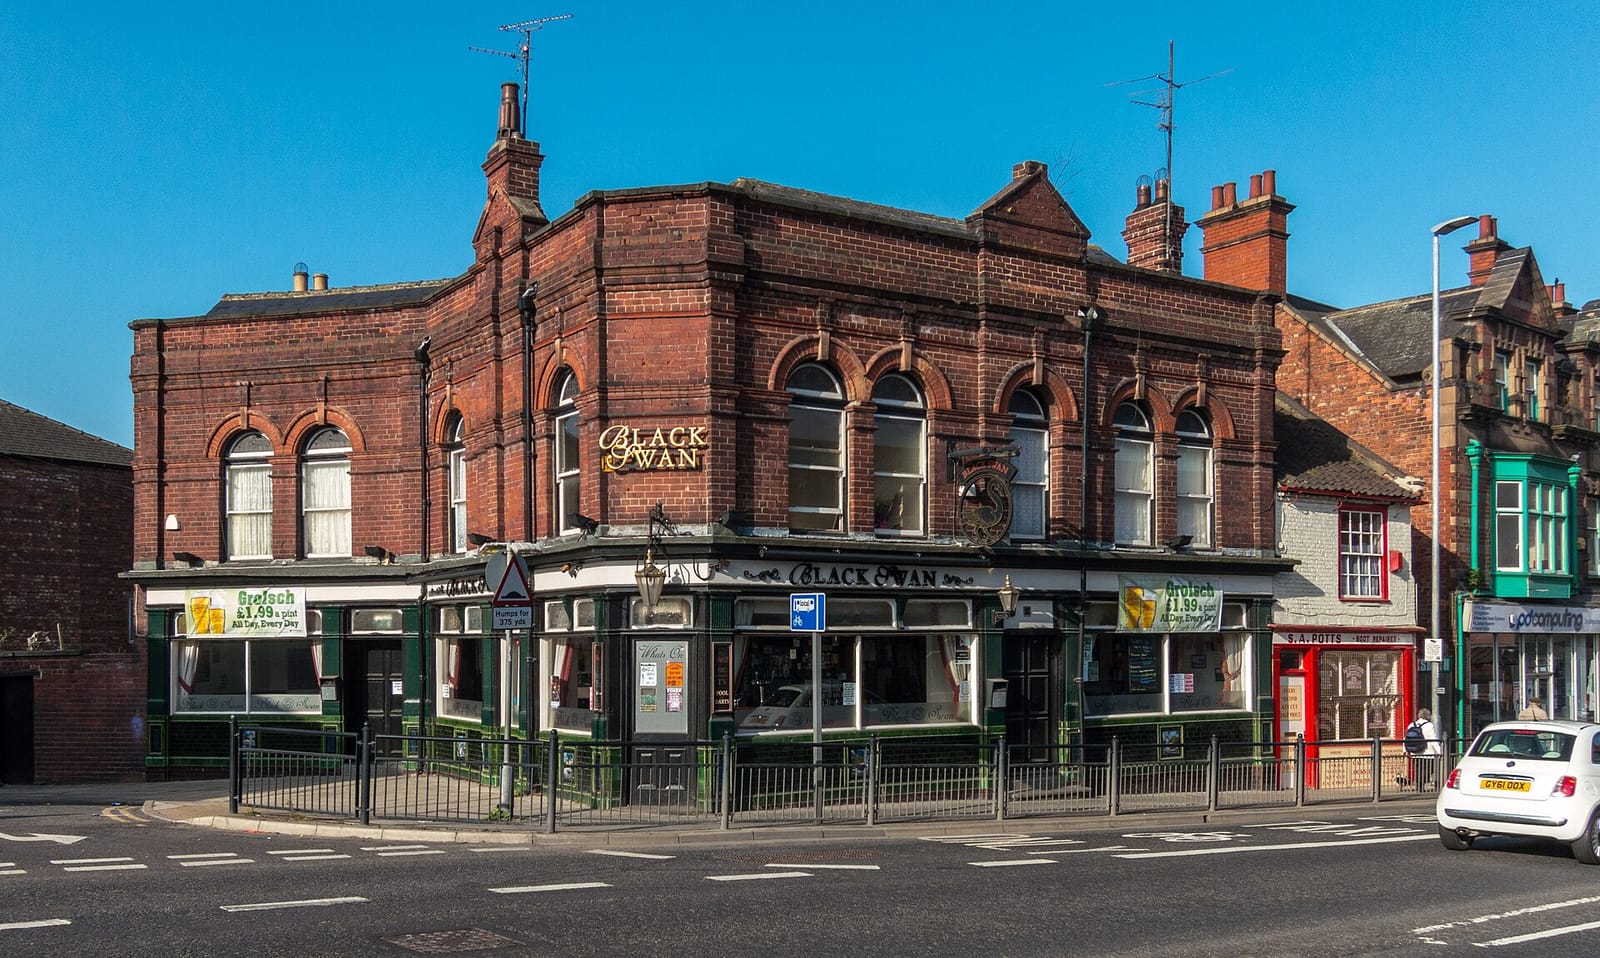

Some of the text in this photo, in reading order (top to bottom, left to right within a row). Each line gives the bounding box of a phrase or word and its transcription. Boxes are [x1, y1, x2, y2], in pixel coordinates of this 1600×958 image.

[599, 425, 706, 449] BLACK
[606, 444, 698, 469] SWAN
[789, 563, 936, 587] BLACK SWAN
[1165, 580, 1214, 598] Grolsch
[238, 589, 295, 605] Grolsch
[236, 606, 274, 619] £1.99
[281, 610, 298, 620] pint
[1165, 599, 1198, 612] £1.99
[1203, 604, 1216, 614] pint
[495, 610, 518, 618] Humps
[1160, 614, 1169, 622] All
[1185, 614, 1203, 624] Every
[232, 620, 244, 629] All
[261, 620, 283, 629] Every
[284, 620, 299, 629] Day
[499, 618, 526, 628] 375 yds
[1311, 633, 1342, 644] POTTS
[639, 644, 684, 659] Whats On
[1485, 780, 1505, 789] GY61
